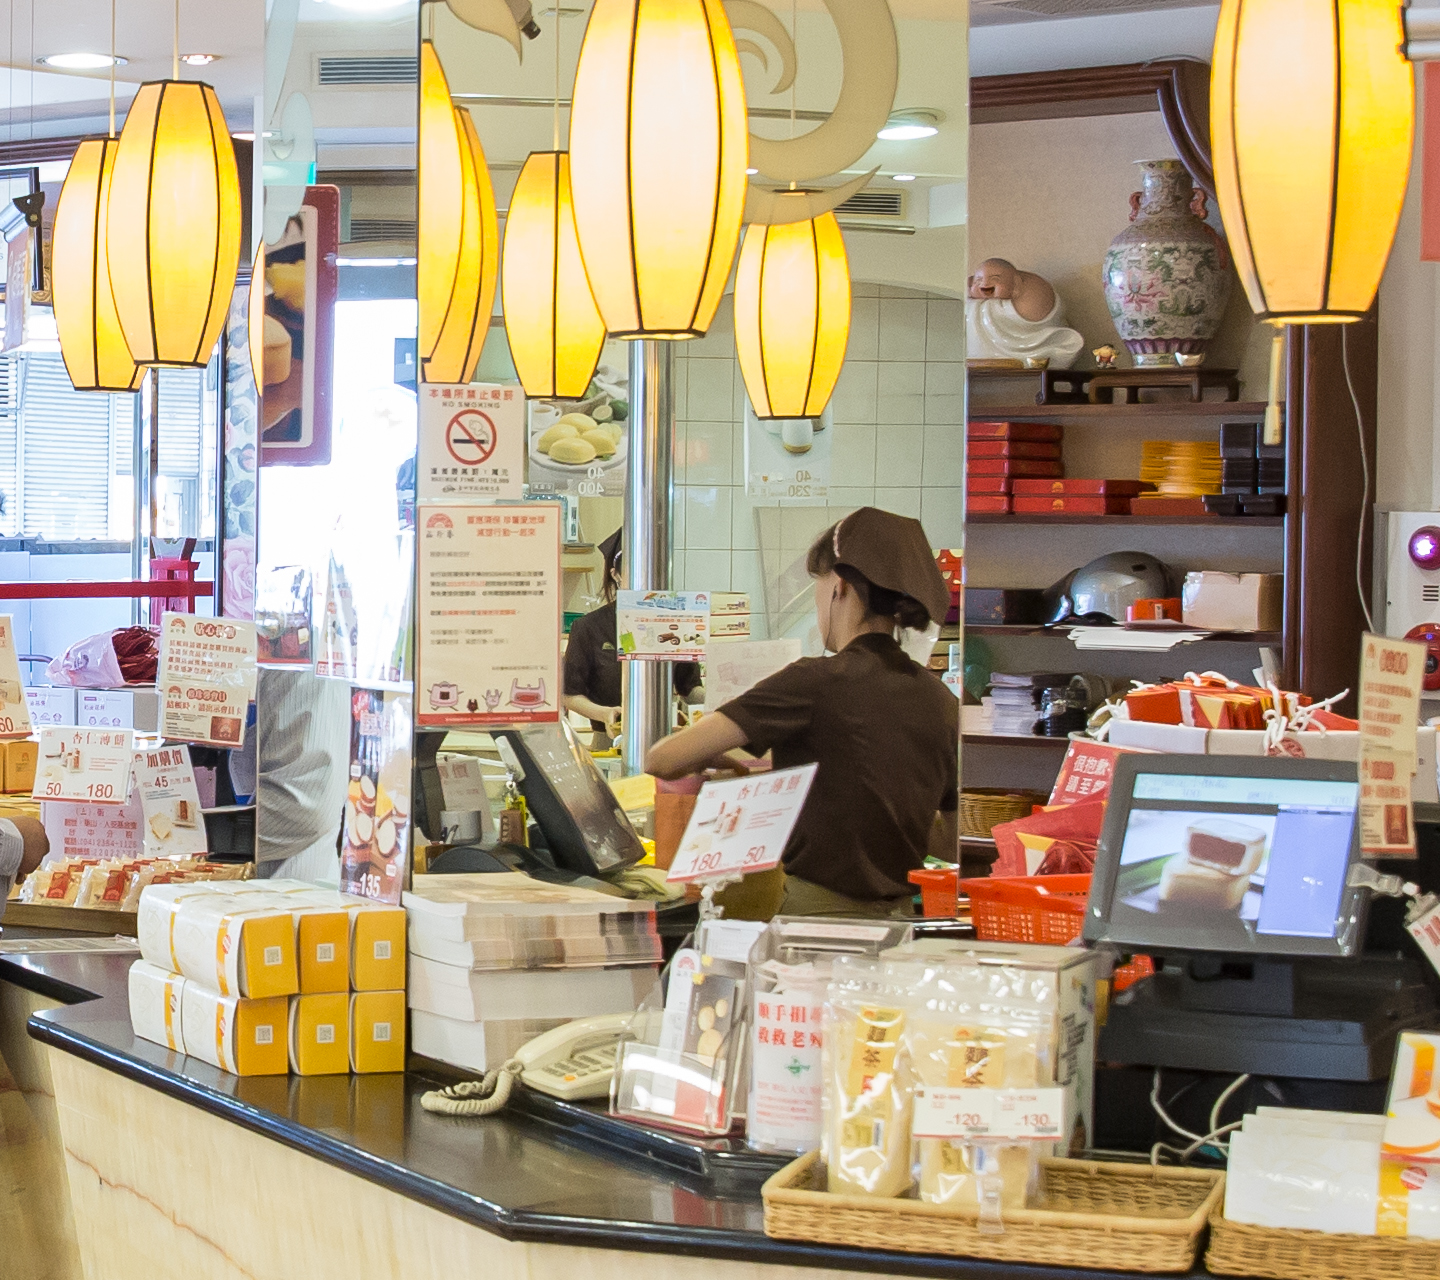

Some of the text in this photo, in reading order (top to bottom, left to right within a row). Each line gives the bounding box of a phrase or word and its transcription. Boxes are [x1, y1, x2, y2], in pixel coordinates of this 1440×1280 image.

[45, 782, 114, 799] 50 180
[154, 776, 169, 788] 45
[691, 844, 766, 875] 180 50
[359, 874, 381, 897] 135
[952, 1112, 1050, 1127] 120 130
